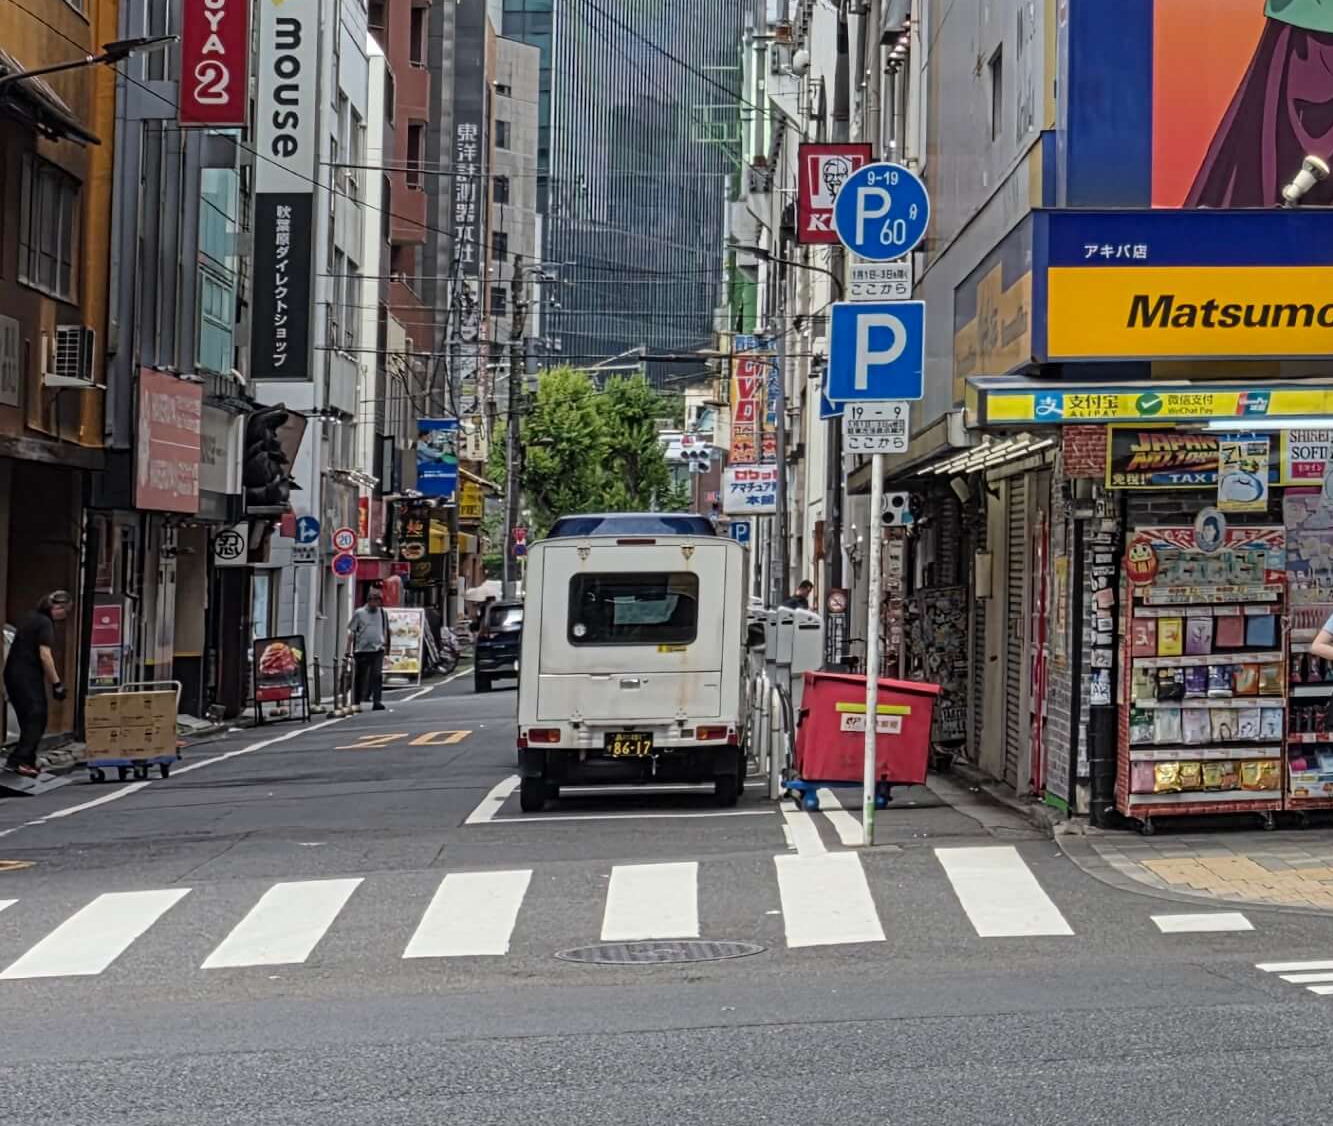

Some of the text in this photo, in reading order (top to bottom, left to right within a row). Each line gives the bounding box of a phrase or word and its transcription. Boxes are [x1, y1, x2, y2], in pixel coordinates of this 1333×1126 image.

[194, 61, 230, 105] 2
[271, 17, 302, 158] mouse
[867, 171, 899, 186] 9-19
[856, 187, 891, 246] P
[880, 219, 905, 245] 60
[1083, 243, 1148, 260] アキバ店
[273, 205, 292, 367] 秋葉原ダイレクトショップ
[851, 282, 907, 296] ここから
[854, 313, 908, 391] P
[1070, 394, 1119, 410] 支付宝
[849, 437, 904, 449] ここから
[1168, 474, 1208, 484] TAX
